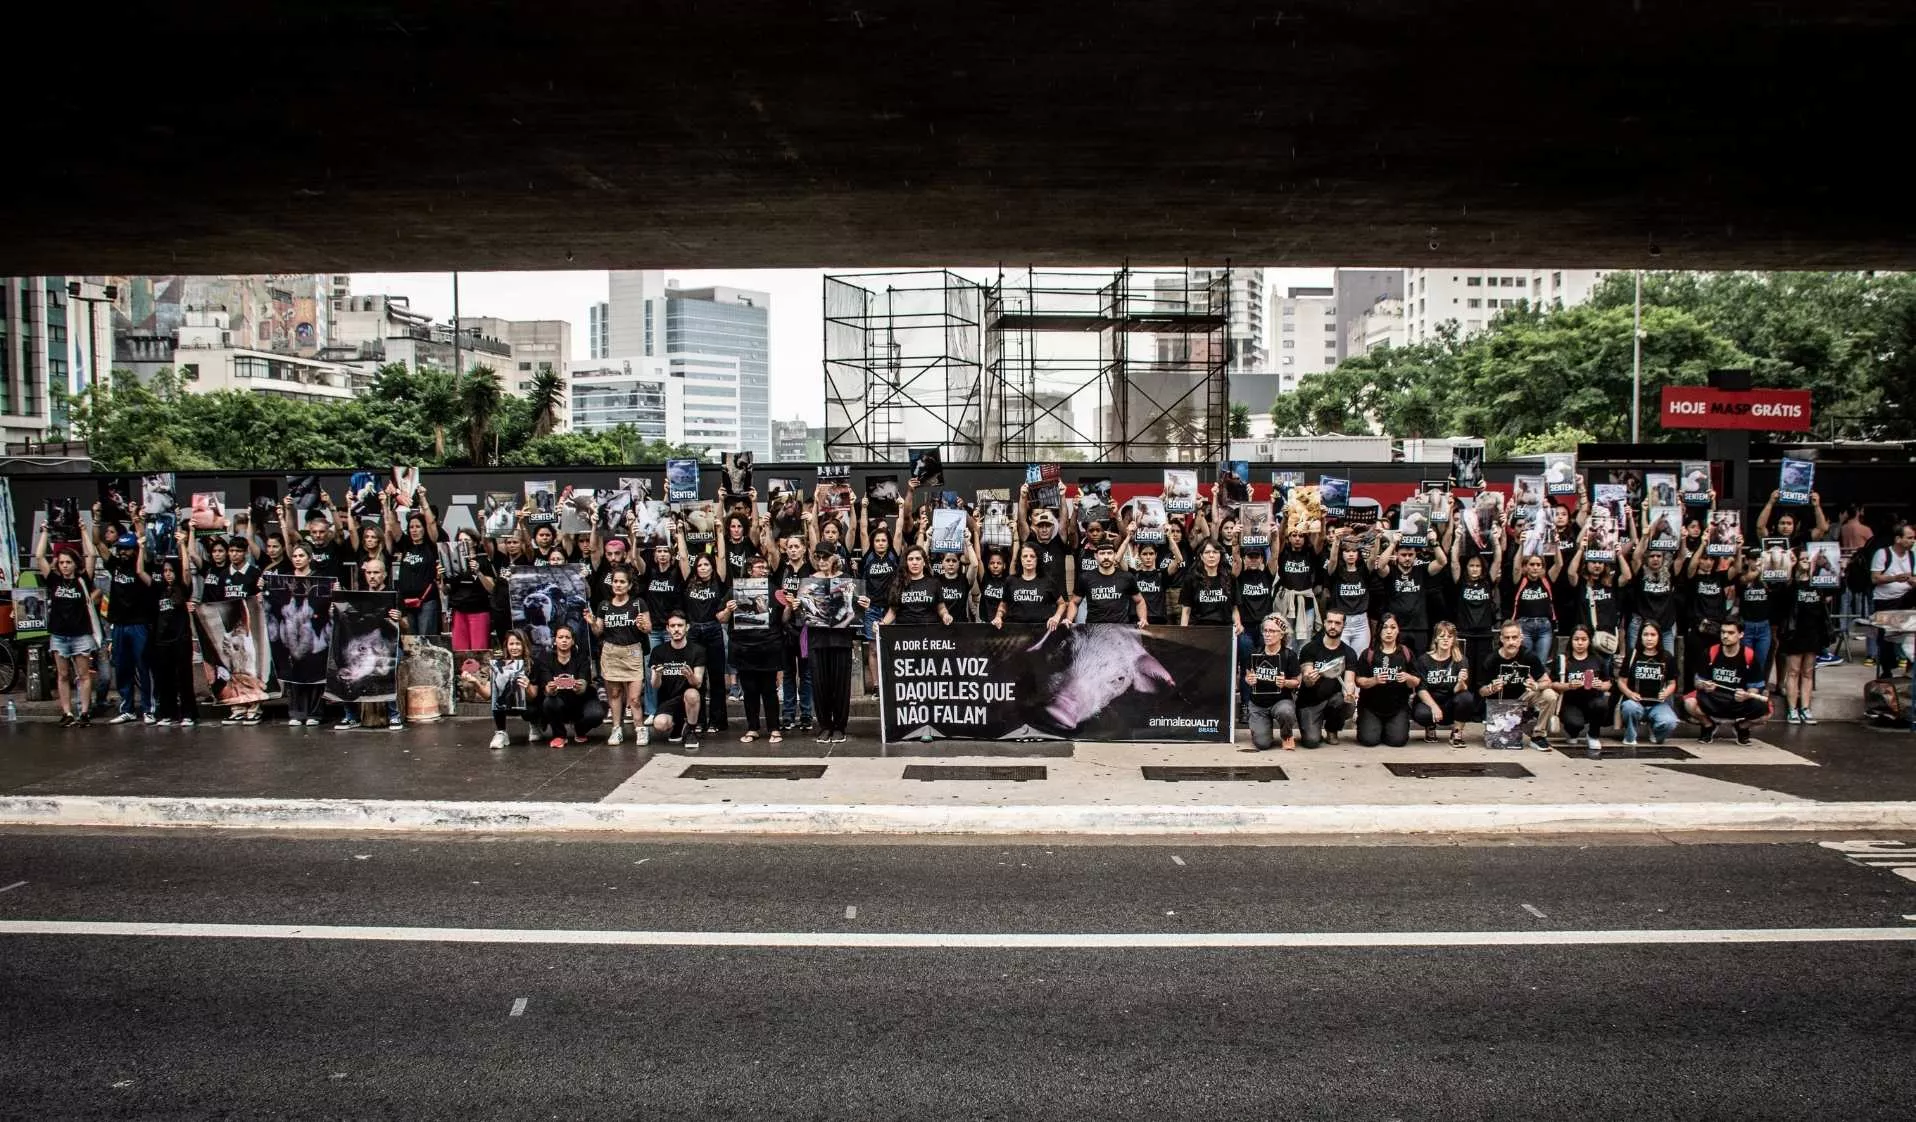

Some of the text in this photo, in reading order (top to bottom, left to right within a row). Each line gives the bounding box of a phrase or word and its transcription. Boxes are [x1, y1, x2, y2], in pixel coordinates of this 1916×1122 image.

[1670, 402, 1802, 417] HOJE MASP GRÁTIS
[1550, 483, 1574, 492] SENTEM
[671, 490, 697, 499] SENTEM
[1684, 492, 1709, 501] SENTEM
[1782, 490, 1808, 501] SENTEM
[1168, 500, 1193, 509] SENTEM
[530, 512, 555, 521] SENTEM
[687, 532, 714, 540] SENTEM
[1136, 530, 1162, 540] SENTEM
[1243, 535, 1268, 544] SENTEM
[934, 540, 962, 549] SENTEM
[1402, 536, 1426, 545] SENTEM
[1652, 539, 1677, 549] SENTEM
[1710, 543, 1735, 553] SENTEM
[1587, 550, 1614, 559] SENTEM
[1764, 570, 1788, 578] SENTEM
[1812, 576, 1838, 584] SENTEM
[1091, 585, 1115, 594] animal
[1014, 594, 1043, 602] EQUALITY
[17, 619, 46, 629] SENTEM
[894, 638, 956, 651] A DOR É REAL:
[894, 658, 989, 678] SEJA A VOZ
[1635, 666, 1661, 674] animal
[895, 682, 1016, 704] DAQUELES QUE
[897, 702, 987, 726] NÃO FALAM
[1149, 716, 1219, 727] animalEQUALITY
